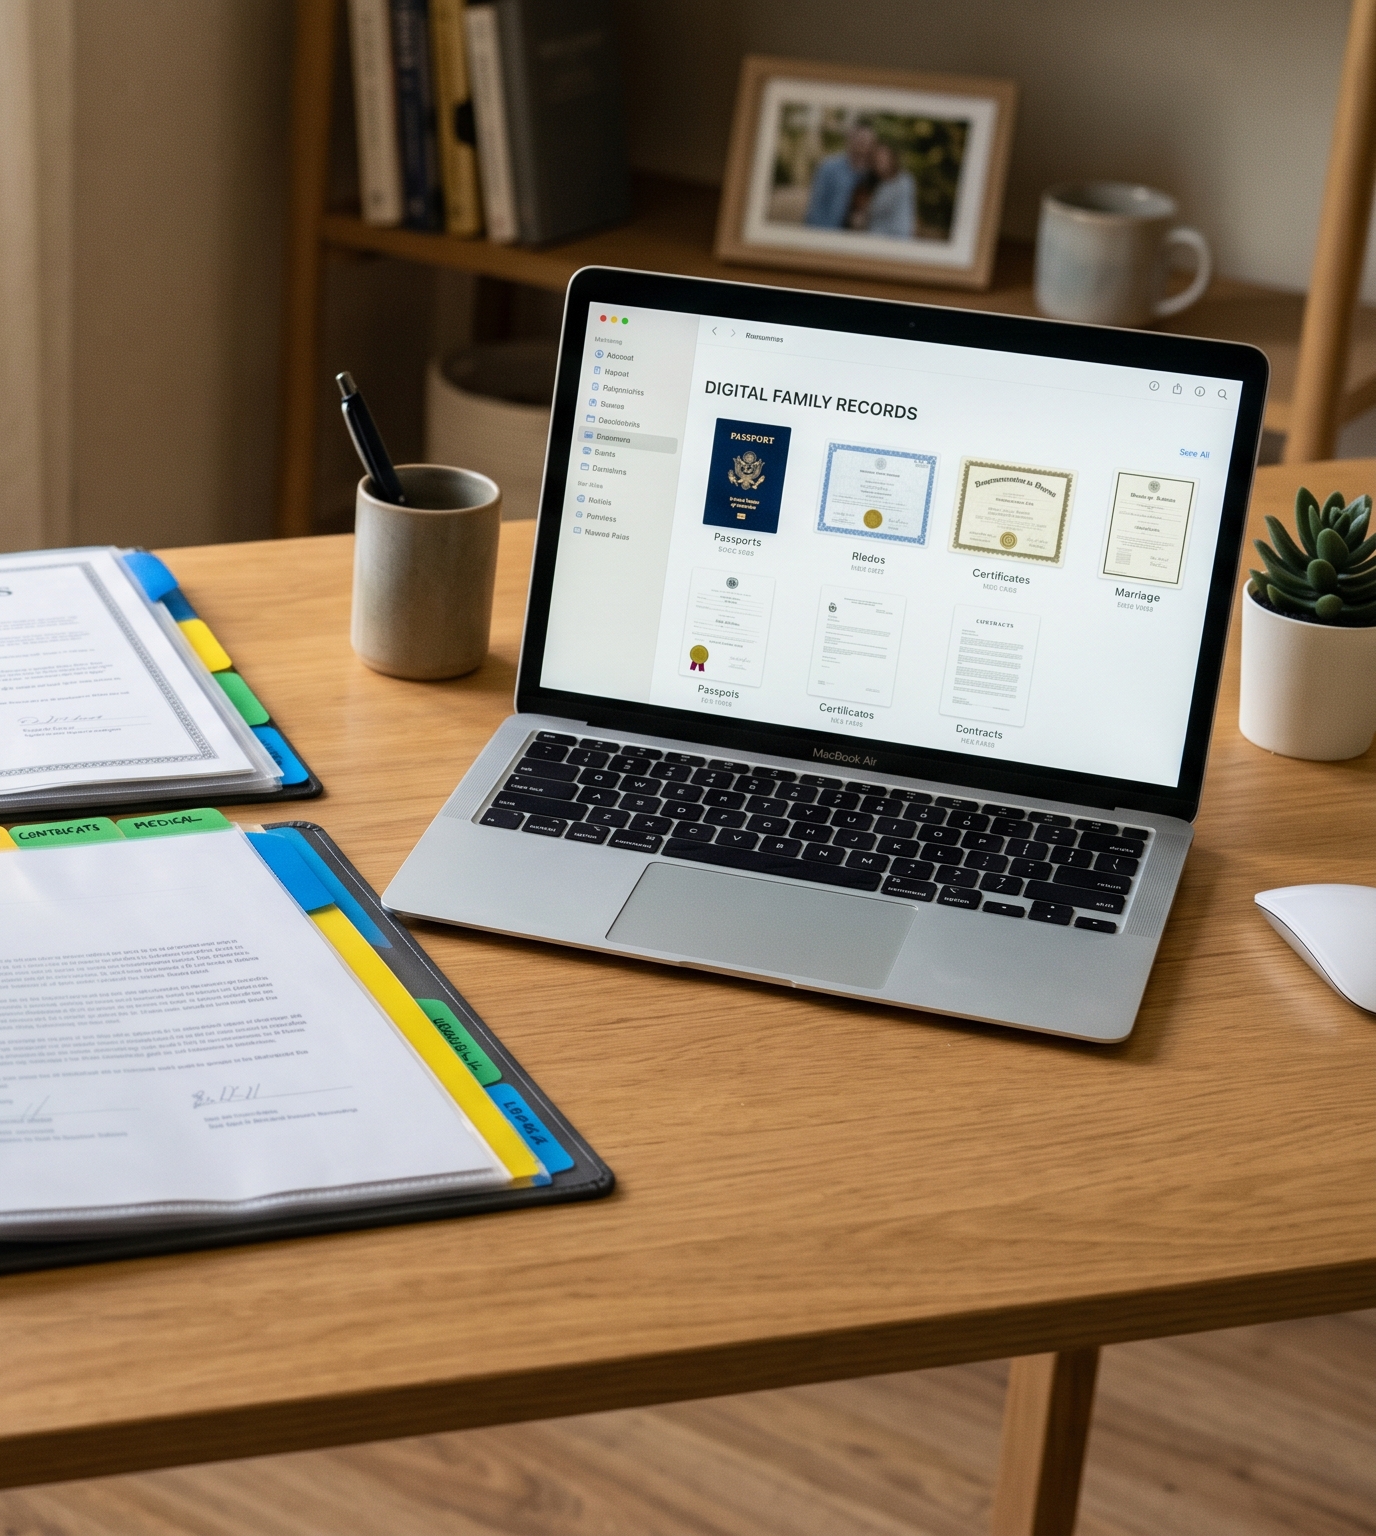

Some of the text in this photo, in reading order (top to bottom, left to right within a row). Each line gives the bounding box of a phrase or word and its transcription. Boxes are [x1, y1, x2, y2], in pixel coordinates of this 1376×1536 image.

[704, 380, 918, 421] DIGITAL FAMILY RECORDS
[730, 432, 775, 444] PASSPORT
[1200, 451, 1210, 459] All
[714, 532, 762, 546] Passports
[972, 568, 1031, 585] Certificates
[1114, 587, 1161, 604] Marriage
[955, 724, 1003, 740] Contracts
[812, 748, 878, 766] MacBook Air
[133, 815, 203, 830] MEDICAL
